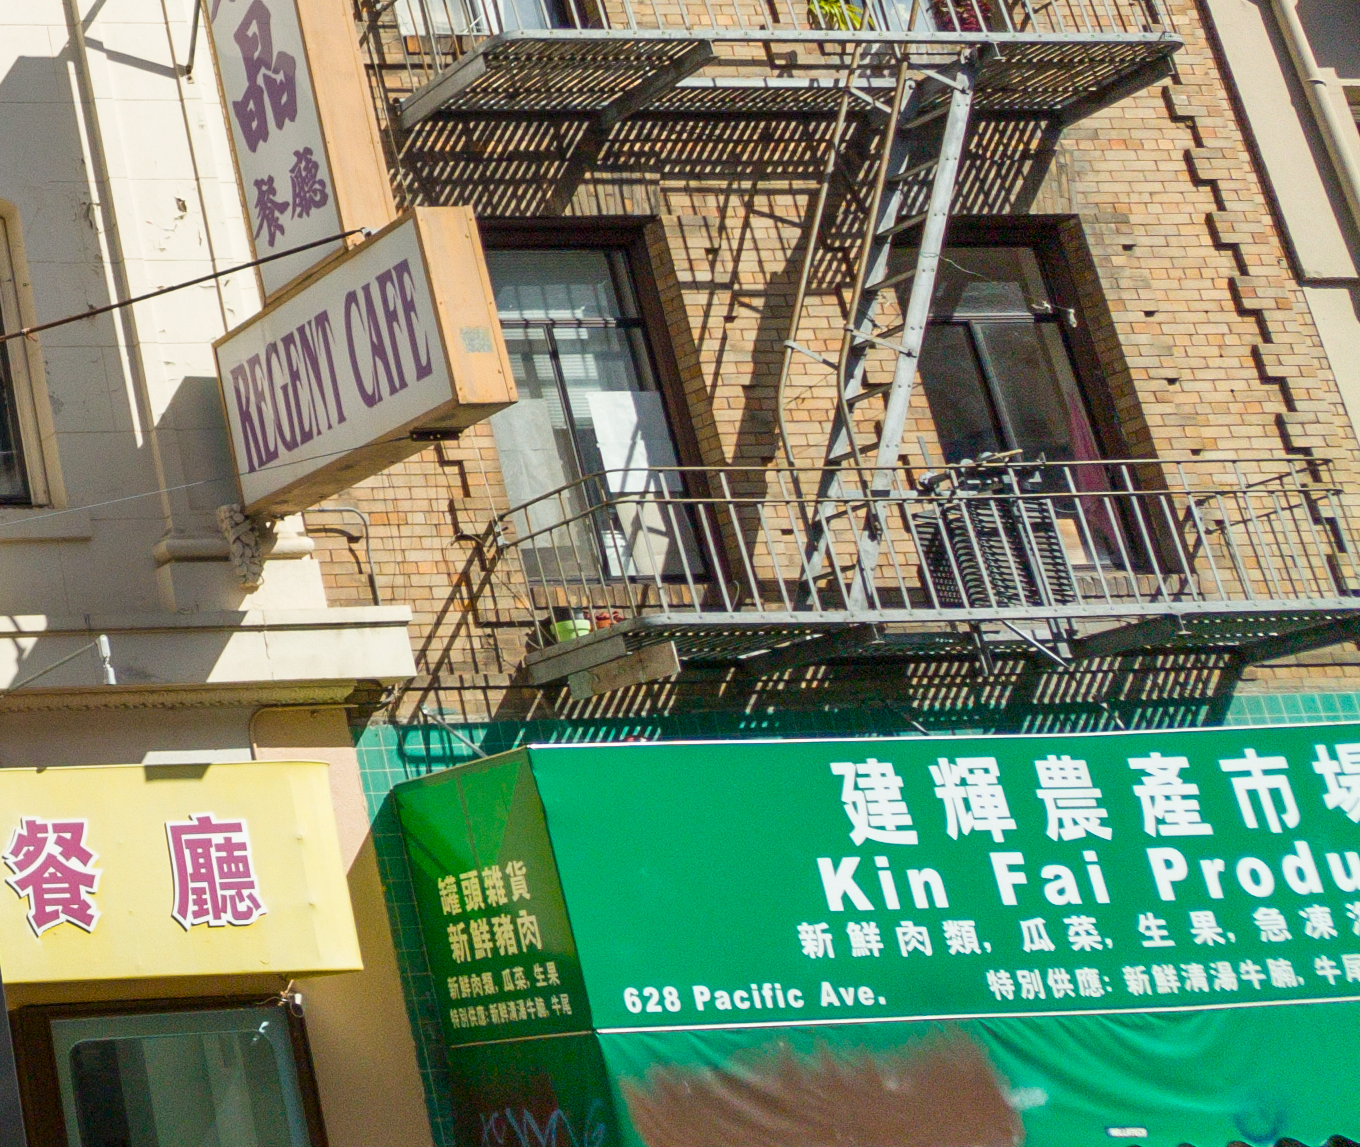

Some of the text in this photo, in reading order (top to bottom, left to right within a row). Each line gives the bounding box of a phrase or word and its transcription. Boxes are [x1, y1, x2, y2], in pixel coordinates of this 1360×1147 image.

[230, 258, 433, 473] REGENT CAFE
[829, 742, 1360, 846] 建輝農產市場
[2, 812, 268, 937] 餐廳
[438, 860, 531, 916] 罐頭雜貨
[816, 855, 949, 912] Kin
[989, 850, 1111, 906] Fai
[447, 909, 543, 964] 新鮮豬肉
[623, 980, 887, 1014] 628 Pacific Ave.
